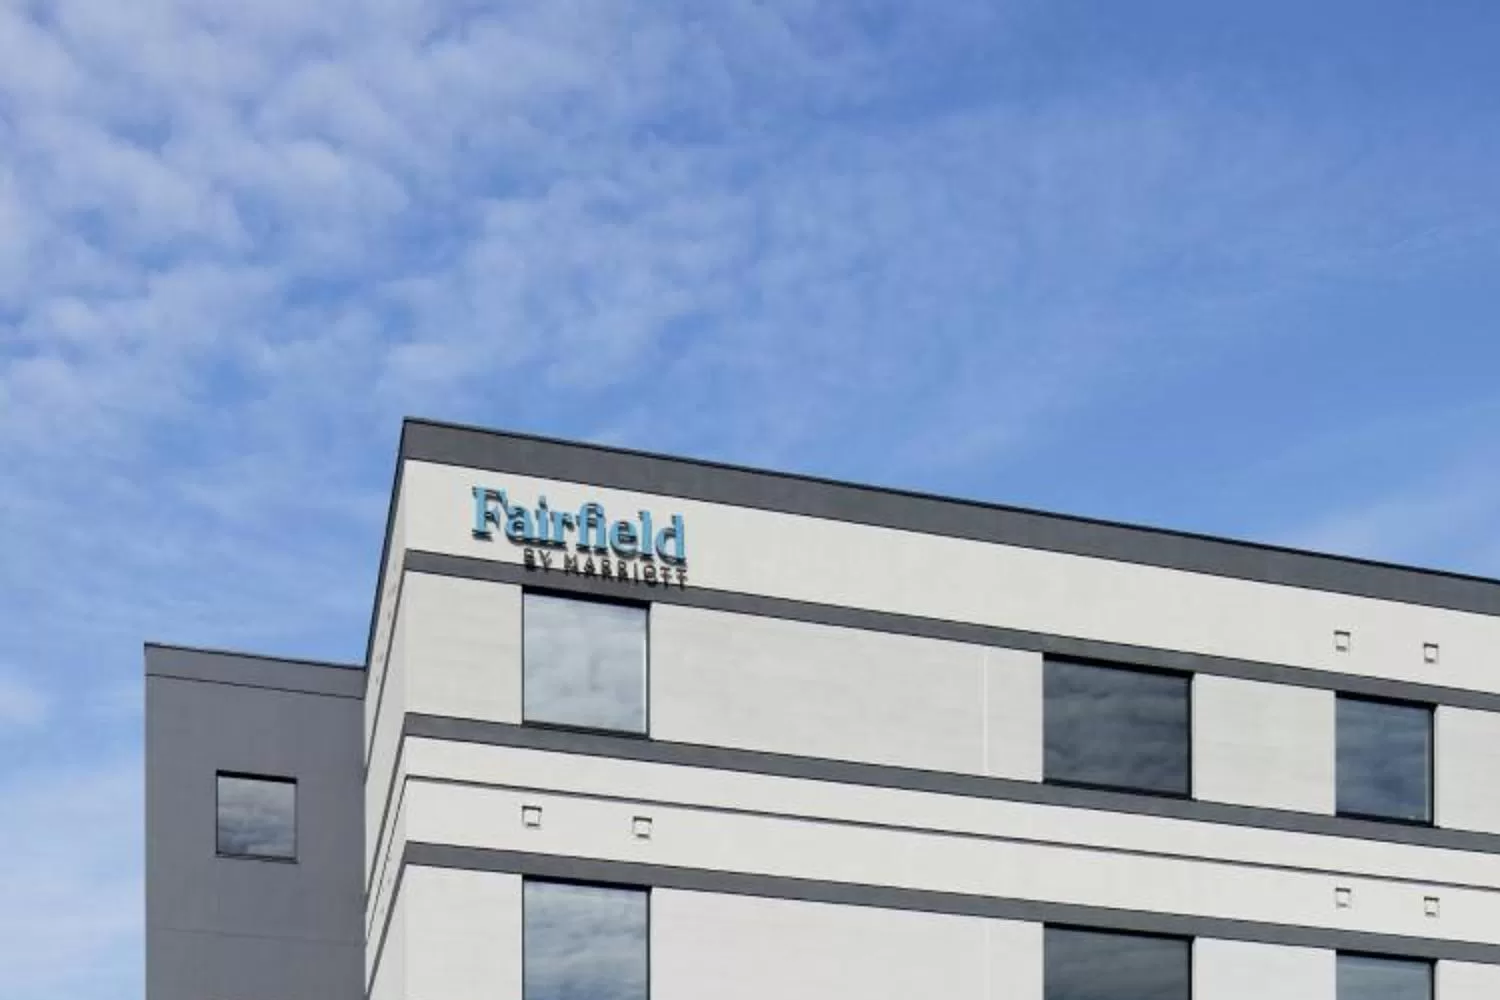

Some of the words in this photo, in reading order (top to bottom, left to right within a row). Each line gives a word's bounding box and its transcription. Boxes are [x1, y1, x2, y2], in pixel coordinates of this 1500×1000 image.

[472, 485, 686, 565] Fairfield
[523, 548, 552, 573] BY
[564, 553, 688, 590] MARRIOTT
